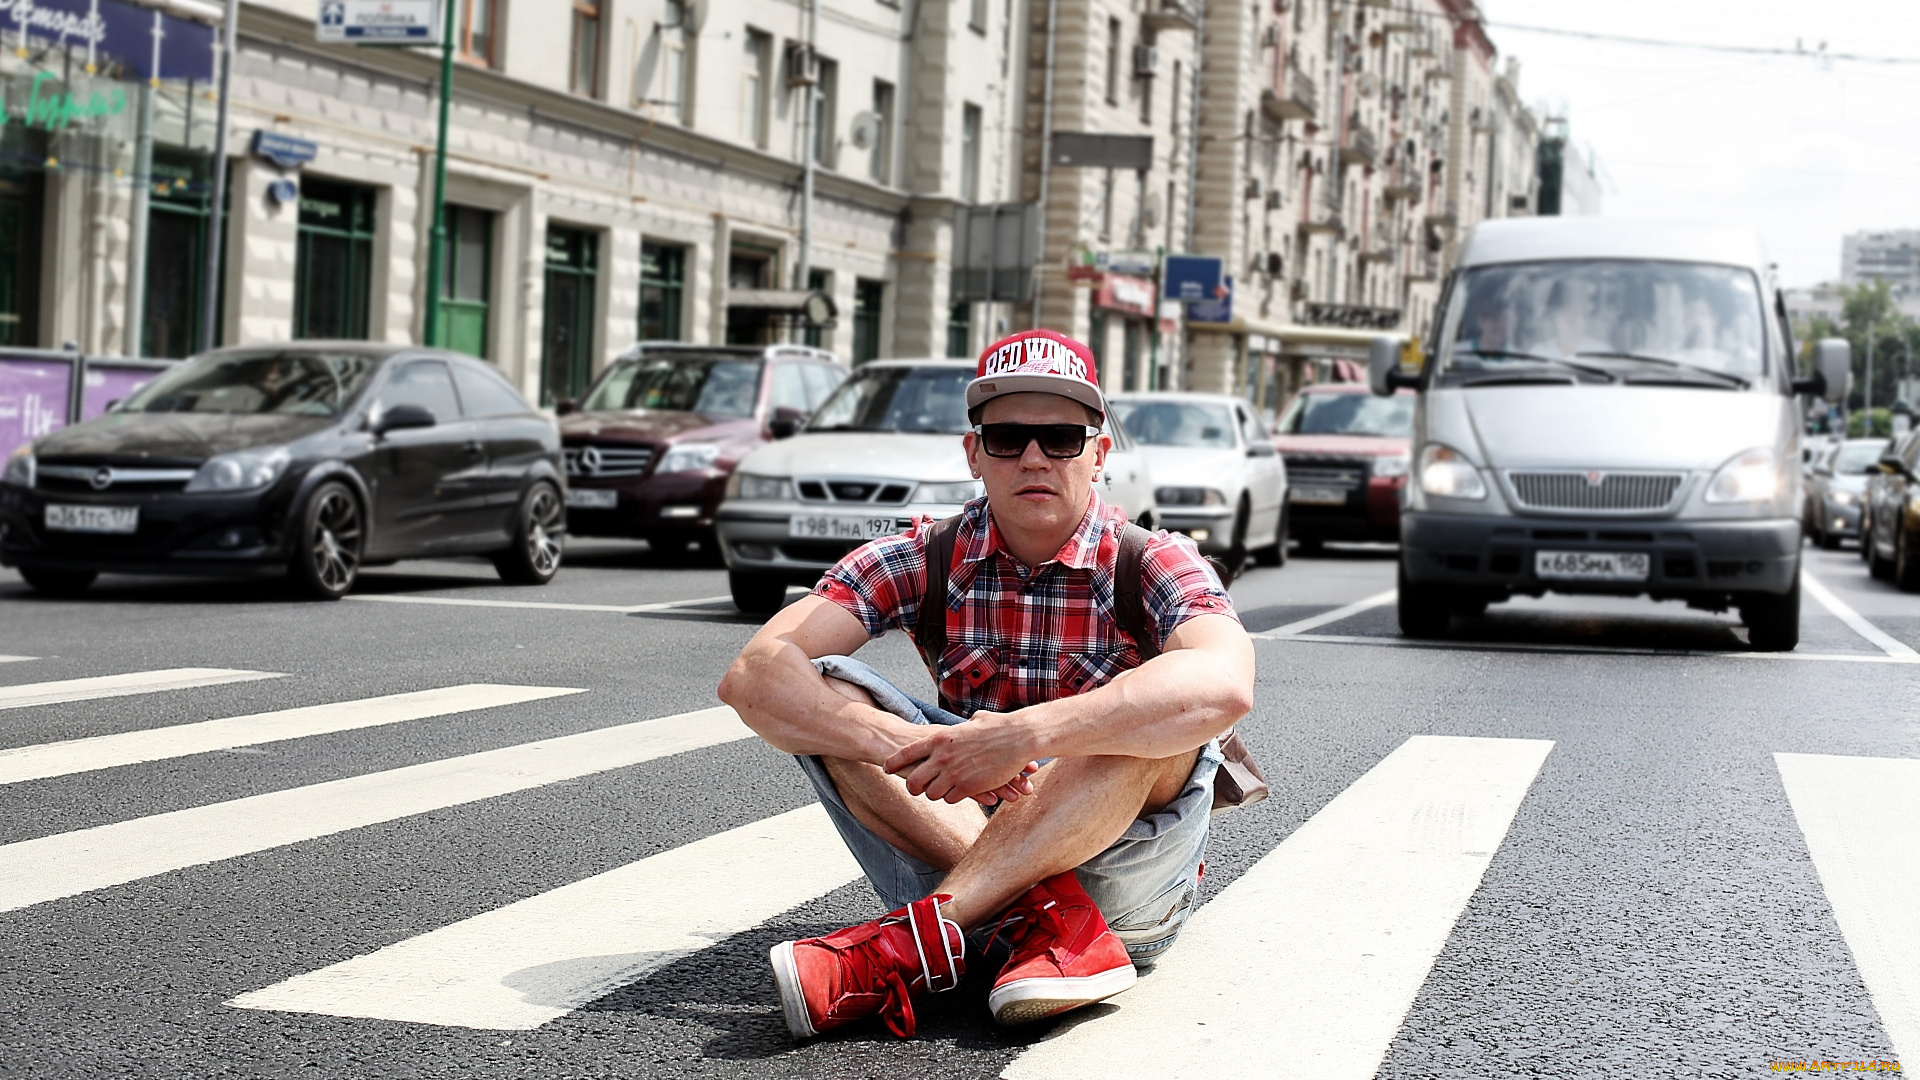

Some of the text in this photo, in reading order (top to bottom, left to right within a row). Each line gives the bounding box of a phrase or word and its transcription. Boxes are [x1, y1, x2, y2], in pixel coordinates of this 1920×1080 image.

[985, 337, 1088, 381] RED WINGS
[866, 519, 891, 533] 197
